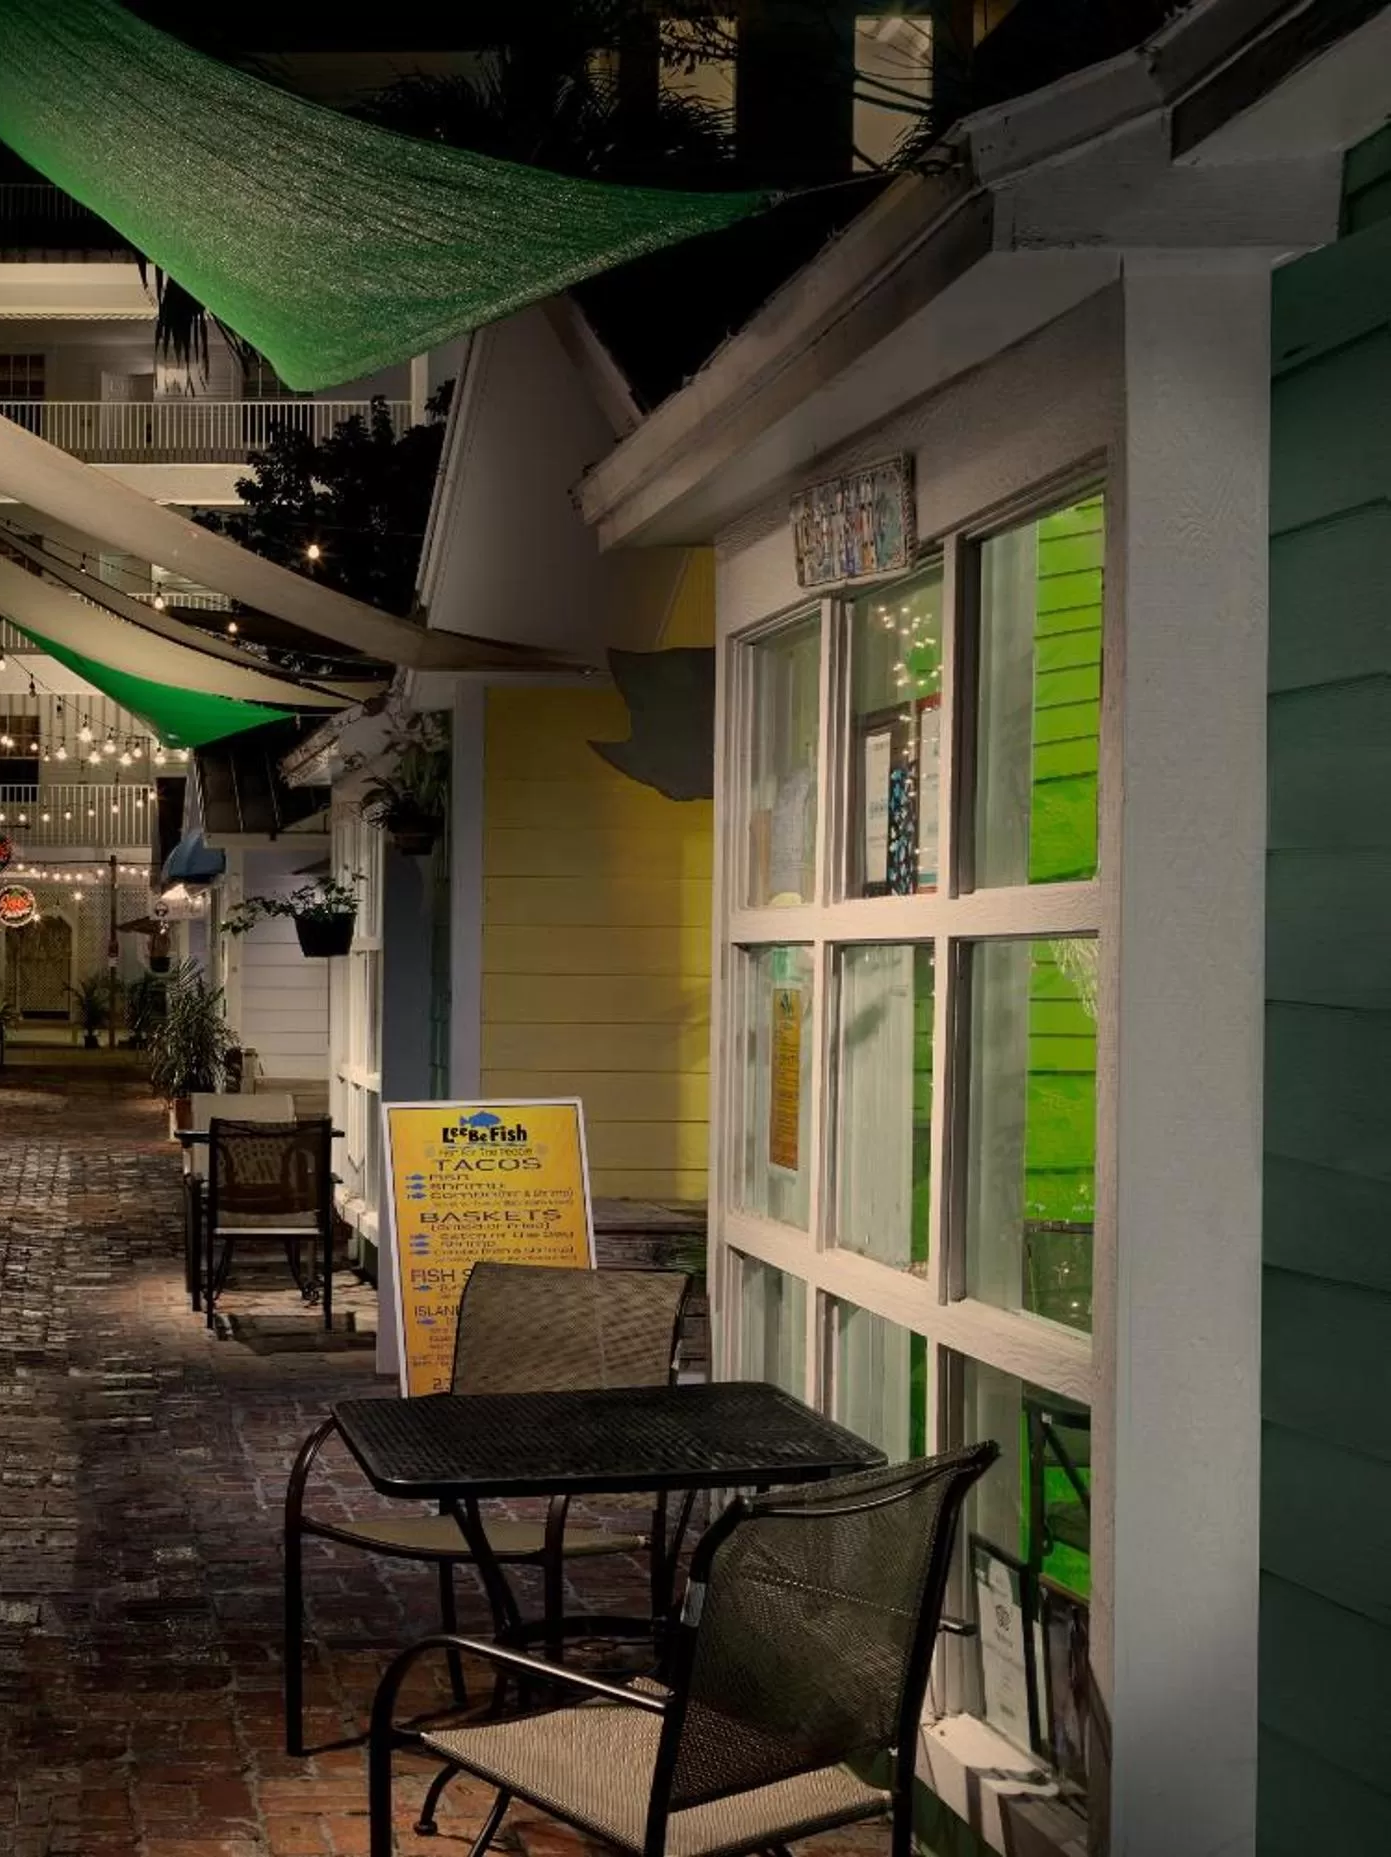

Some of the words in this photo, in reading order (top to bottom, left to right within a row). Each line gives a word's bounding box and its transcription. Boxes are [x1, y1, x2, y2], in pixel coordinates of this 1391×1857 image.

[435, 1157, 542, 1172] TACOS
[420, 1209, 563, 1224] BASKETS
[410, 1268, 455, 1283] FISH
